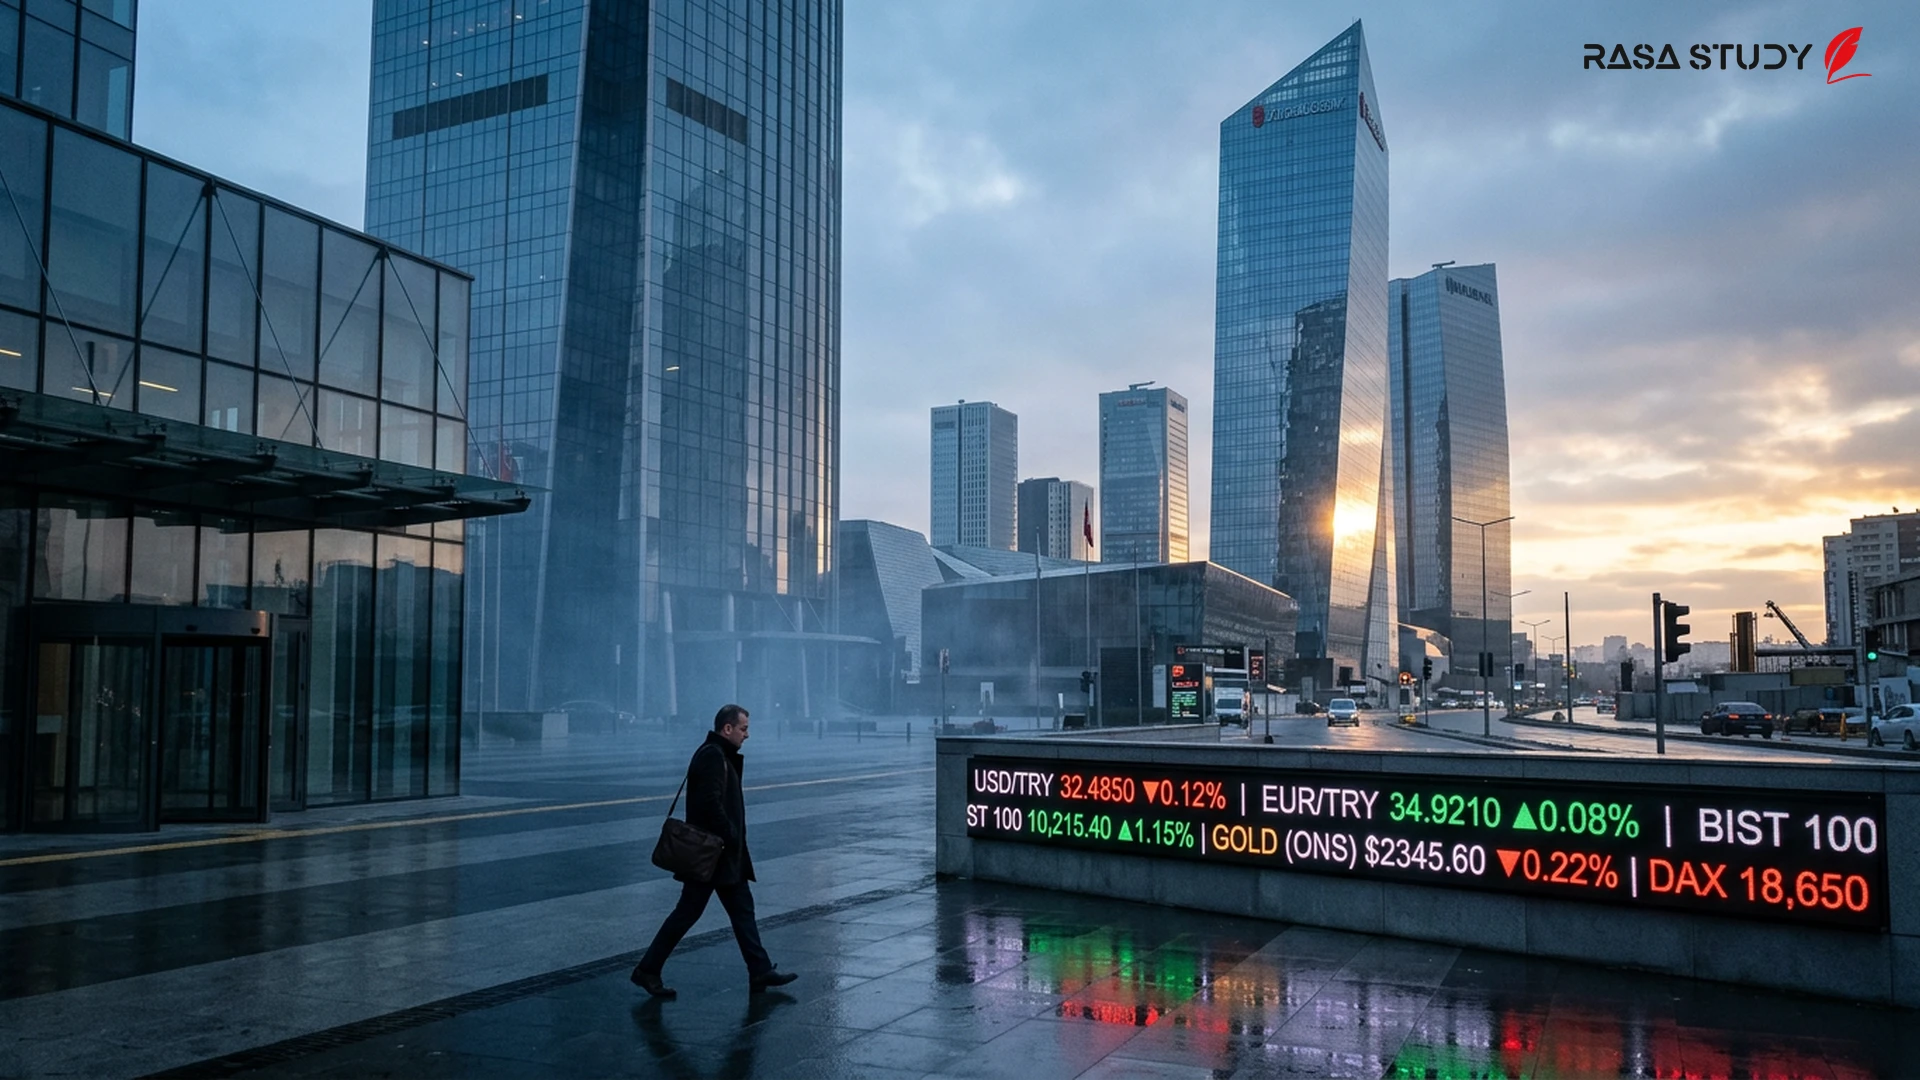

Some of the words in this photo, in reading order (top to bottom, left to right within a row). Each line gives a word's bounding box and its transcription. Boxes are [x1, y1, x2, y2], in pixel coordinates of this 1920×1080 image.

[966, 803, 989, 828] ST
[993, 806, 1022, 832] 100
[1027, 809, 1112, 840] 10,215.40
[1135, 818, 1195, 848] 1.15%
[1212, 823, 1278, 855] GOLD
[1285, 829, 1357, 870] (ONS)
[1364, 834, 1486, 876] $2345.60
[1522, 848, 1619, 889] 0.22%
[1649, 858, 1728, 899] DAX
[1740, 866, 1869, 912] 18,650
[974, 768, 1054, 797] USD/TRY
[1060, 774, 1135, 804] 32.4850
[1160, 780, 1227, 810] 0.12%
[1262, 784, 1380, 820] EUR/TRY
[1389, 791, 1501, 828] 34.9210
[1538, 800, 1640, 839] 0.08%
[1698, 807, 1790, 847] BIST
[1804, 814, 1877, 854] 100
